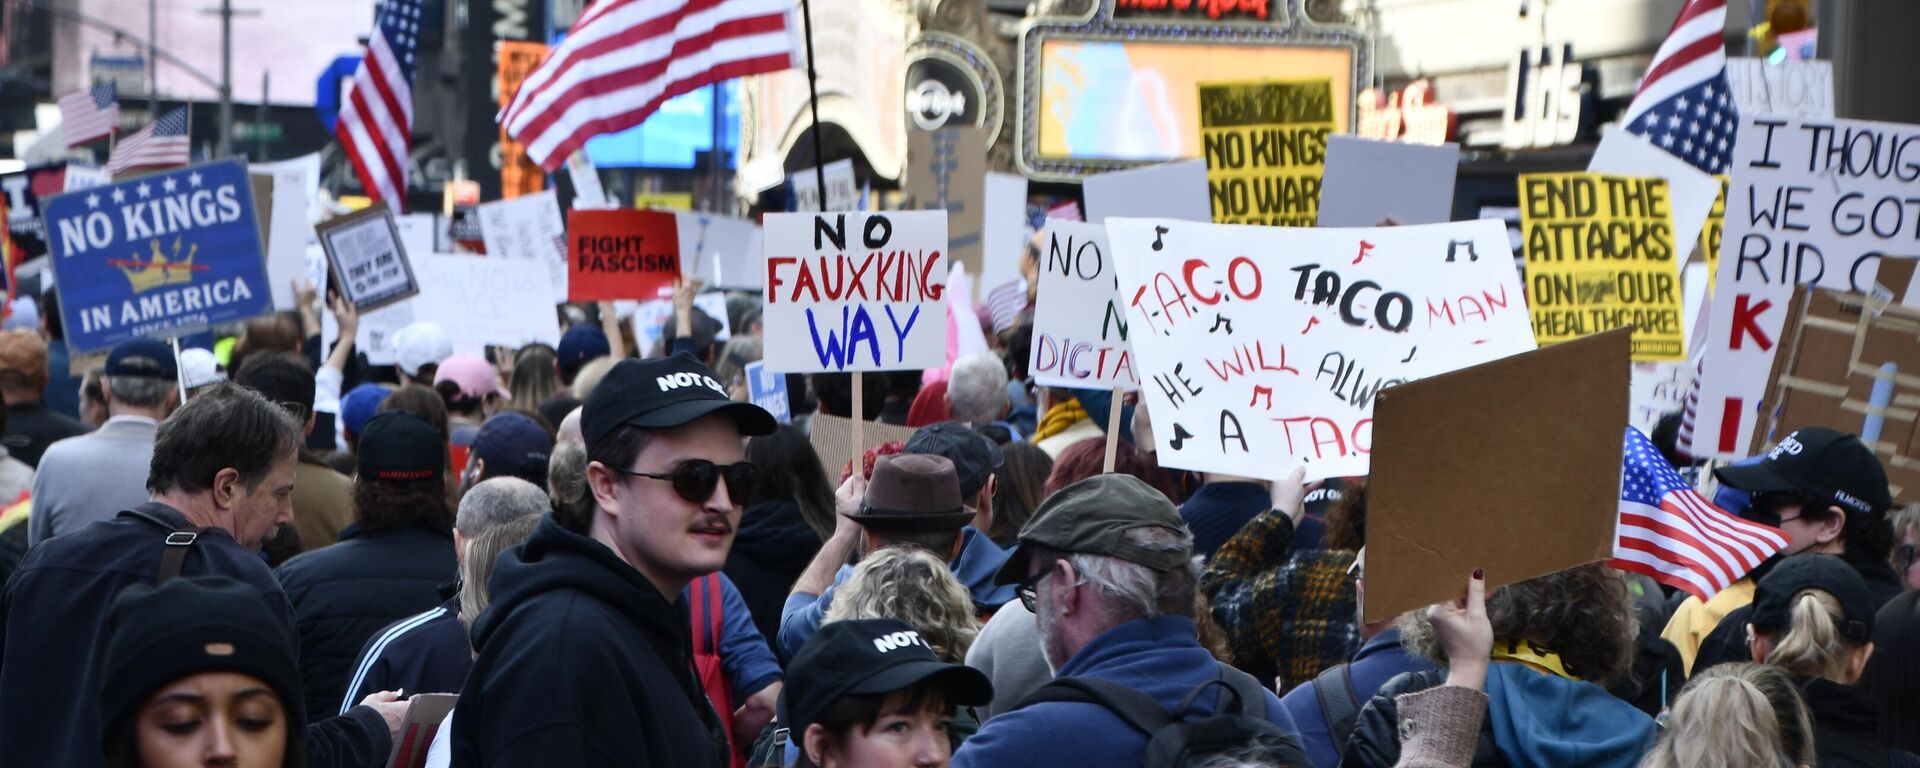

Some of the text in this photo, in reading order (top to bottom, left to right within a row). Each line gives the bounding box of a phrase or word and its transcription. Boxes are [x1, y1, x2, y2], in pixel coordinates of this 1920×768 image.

[1204, 130, 1246, 170] NO
[1749, 119, 1788, 168] I
[1209, 175, 1323, 217] NO WAR
[1526, 178, 1598, 219] END
[1601, 177, 1668, 219] THE
[1749, 184, 1815, 231] WE
[1831, 191, 1920, 241] GOT
[57, 210, 115, 258] NO
[120, 184, 242, 243] KINGS
[814, 213, 893, 251] NO
[1528, 221, 1673, 262] ATTACKS
[578, 235, 645, 254] FIGHT
[578, 255, 675, 273] FASCISM
[1049, 230, 1102, 281] NO
[1735, 233, 1826, 286] RID
[767, 249, 945, 304] FAUXKING
[1534, 271, 1676, 306] ON OUR
[80, 276, 253, 334] IN AMERICA
[1428, 282, 1509, 329] MAN
[1535, 306, 1680, 337] HEALTHCARE!
[804, 303, 920, 371] WAY
[1036, 334, 1142, 386] DICTA
[1153, 362, 1204, 409] HE
[1205, 340, 1300, 382] WILL
[656, 372, 704, 392] NOT
[1219, 408, 1250, 454] A
[379, 470, 433, 479] SURVIVOR
[1834, 488, 1873, 513] FILMCREW
[872, 631, 921, 653] NOT
